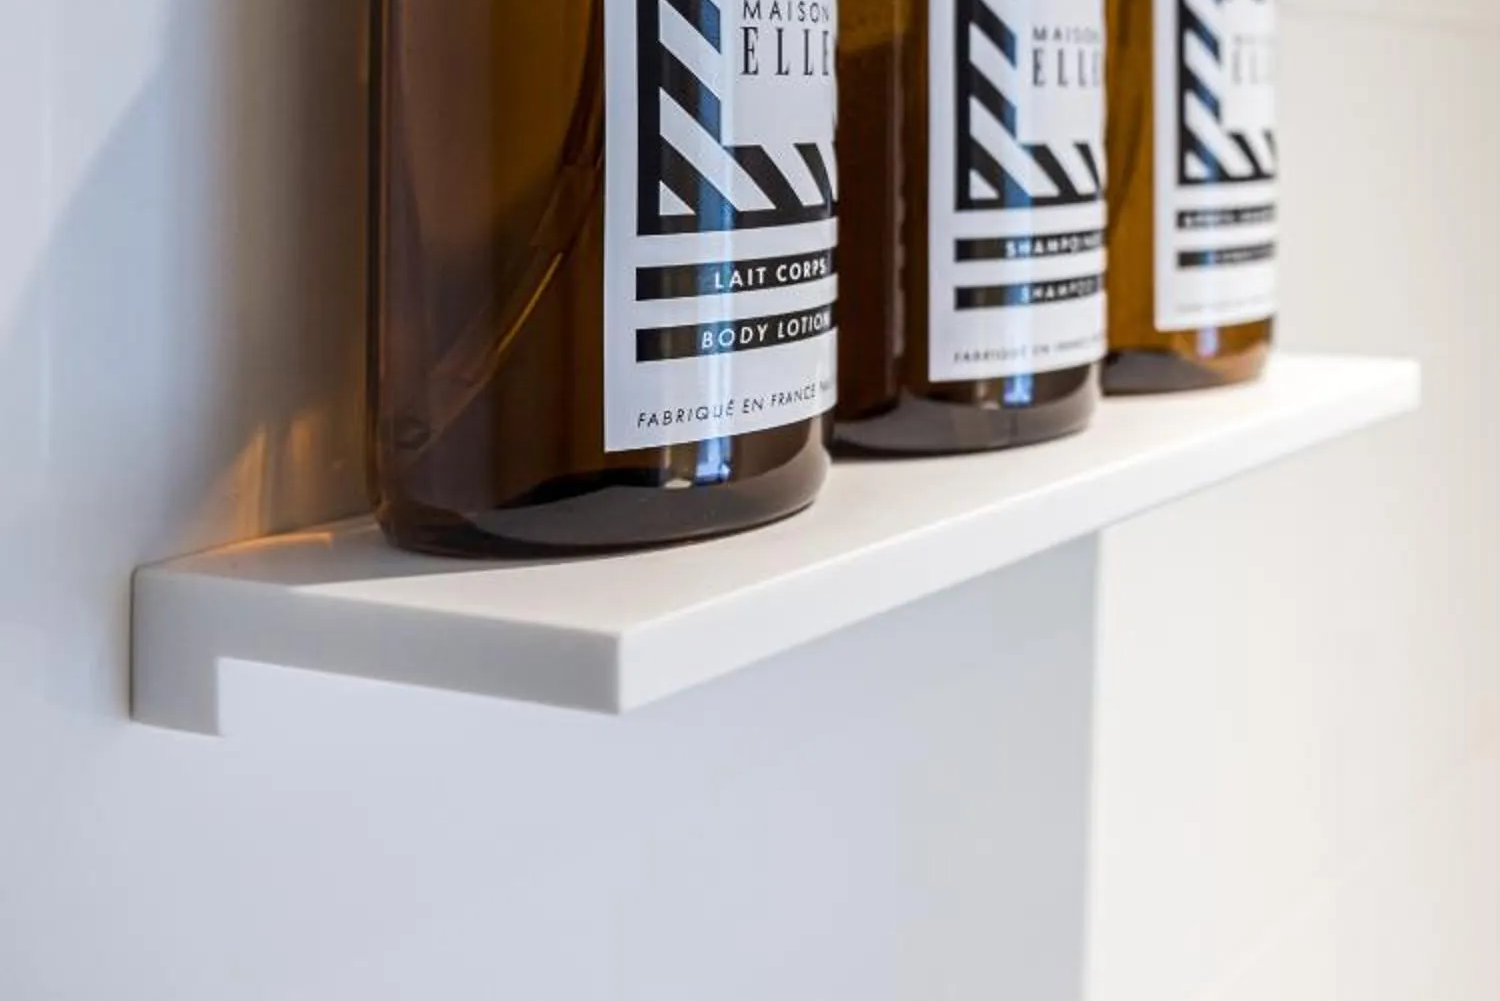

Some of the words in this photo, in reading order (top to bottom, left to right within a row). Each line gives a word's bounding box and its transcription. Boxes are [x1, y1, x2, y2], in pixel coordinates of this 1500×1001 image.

[715, 267, 767, 289] LAIT
[776, 258, 825, 282] CORPS
[701, 324, 768, 349] BODY
[777, 311, 830, 338] LOTION
[742, 398, 765, 414] EN
[771, 383, 817, 407] FRANCE
